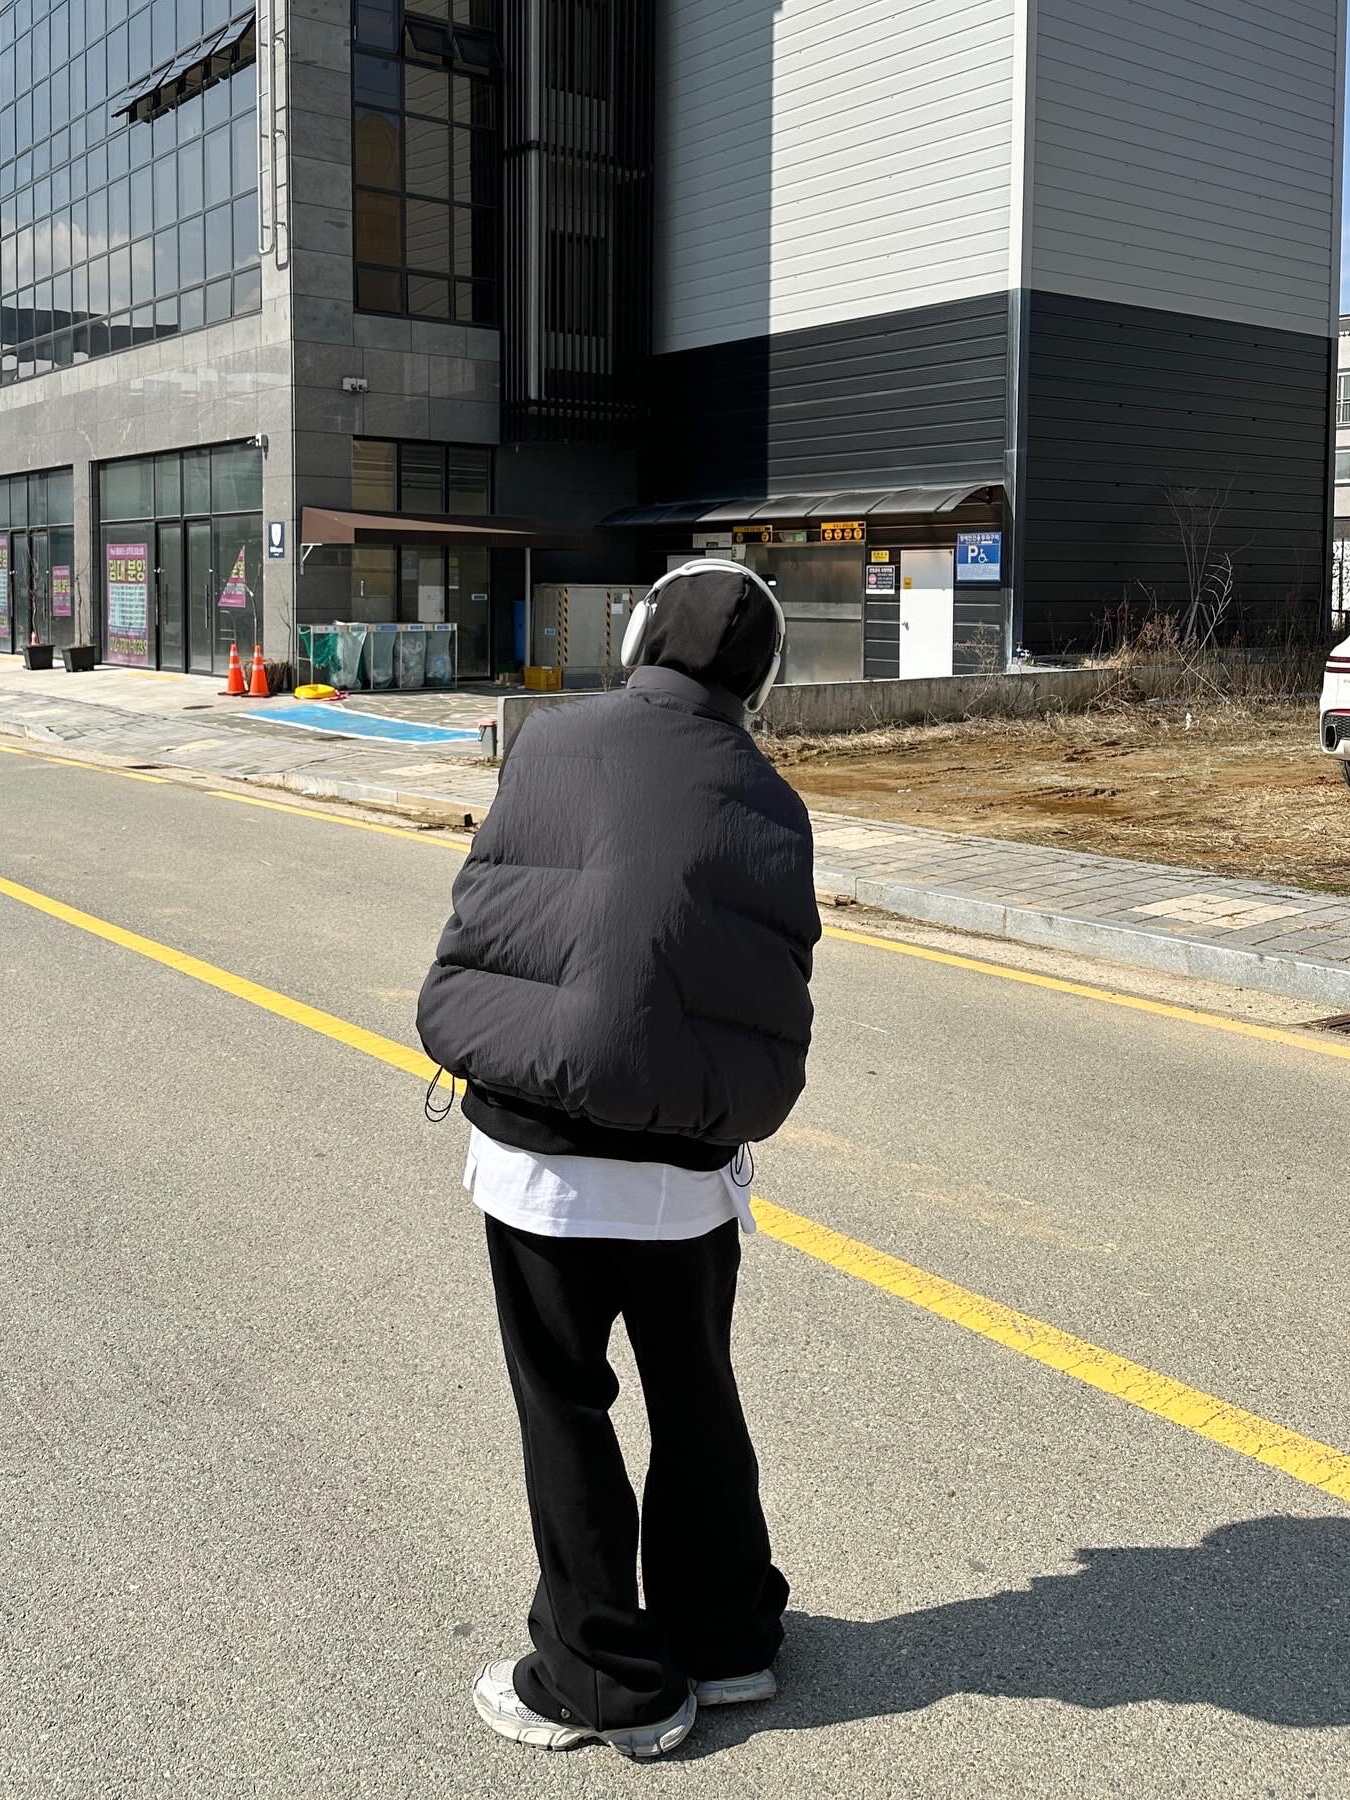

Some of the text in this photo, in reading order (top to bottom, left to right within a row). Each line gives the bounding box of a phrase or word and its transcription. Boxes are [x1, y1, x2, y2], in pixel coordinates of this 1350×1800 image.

[968, 545, 979, 563] P
[109, 560, 146, 581] 임대 분양
